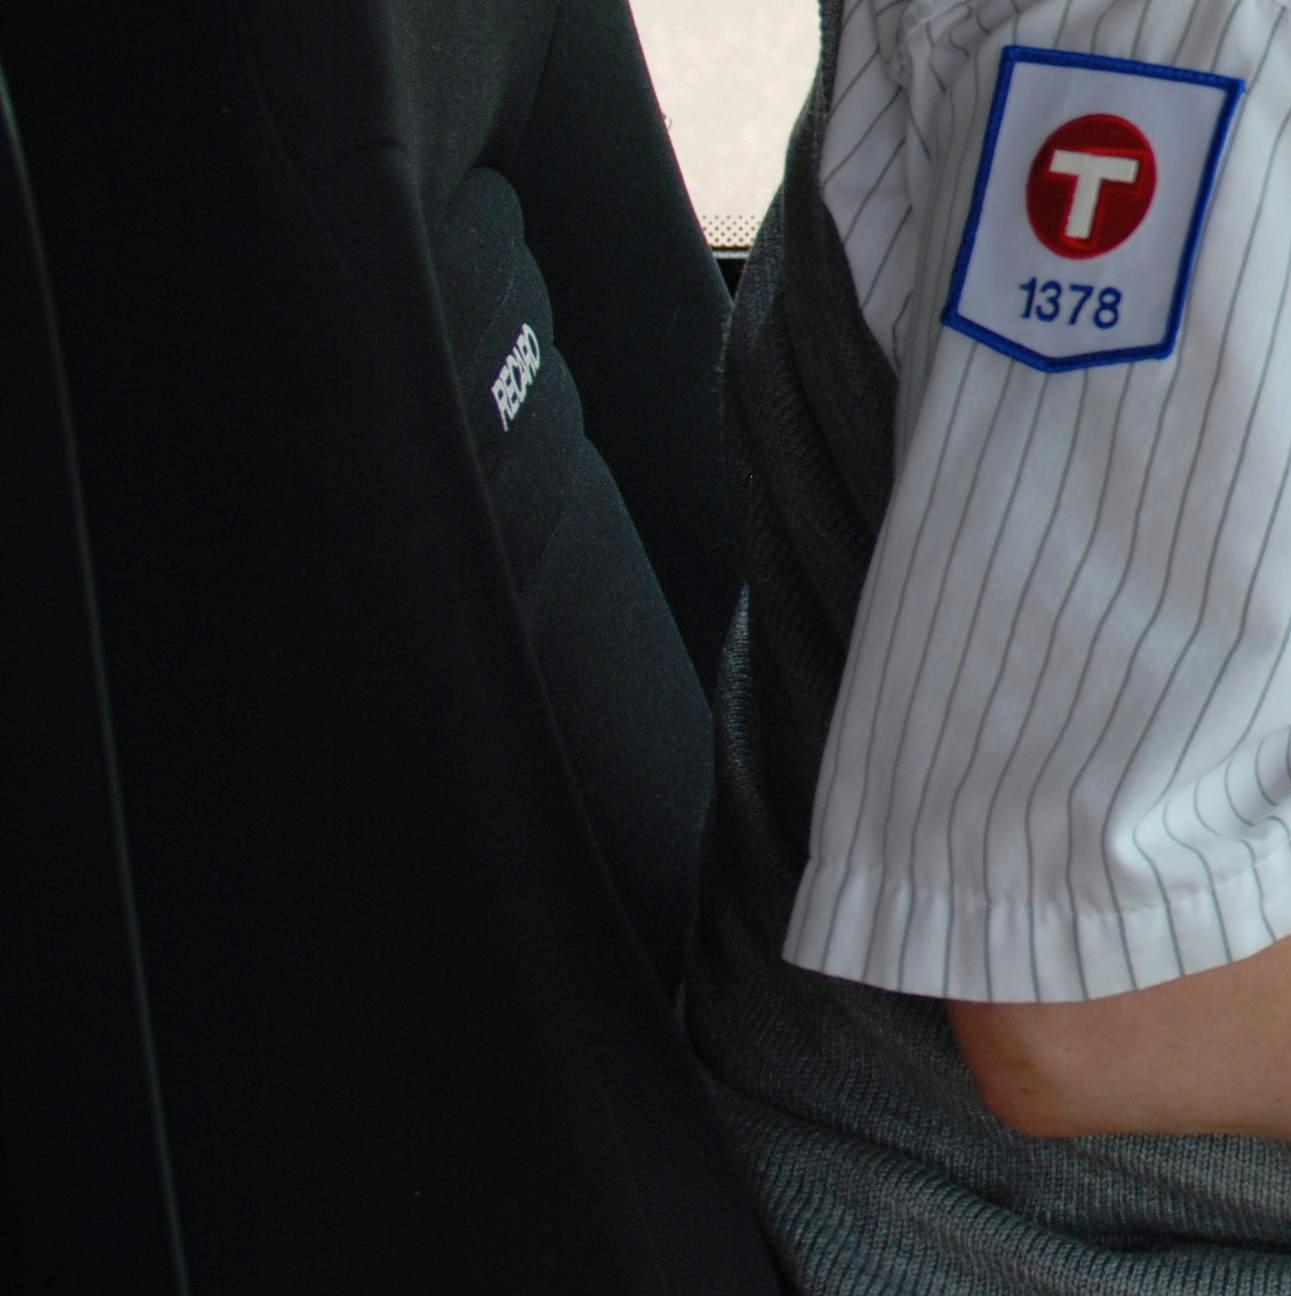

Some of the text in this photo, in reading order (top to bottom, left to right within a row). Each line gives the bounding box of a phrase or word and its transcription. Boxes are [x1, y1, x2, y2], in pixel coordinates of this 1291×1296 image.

[1050, 149, 1139, 239] T
[1019, 277, 1123, 330] 1378
[490, 322, 541, 433] RECARO
